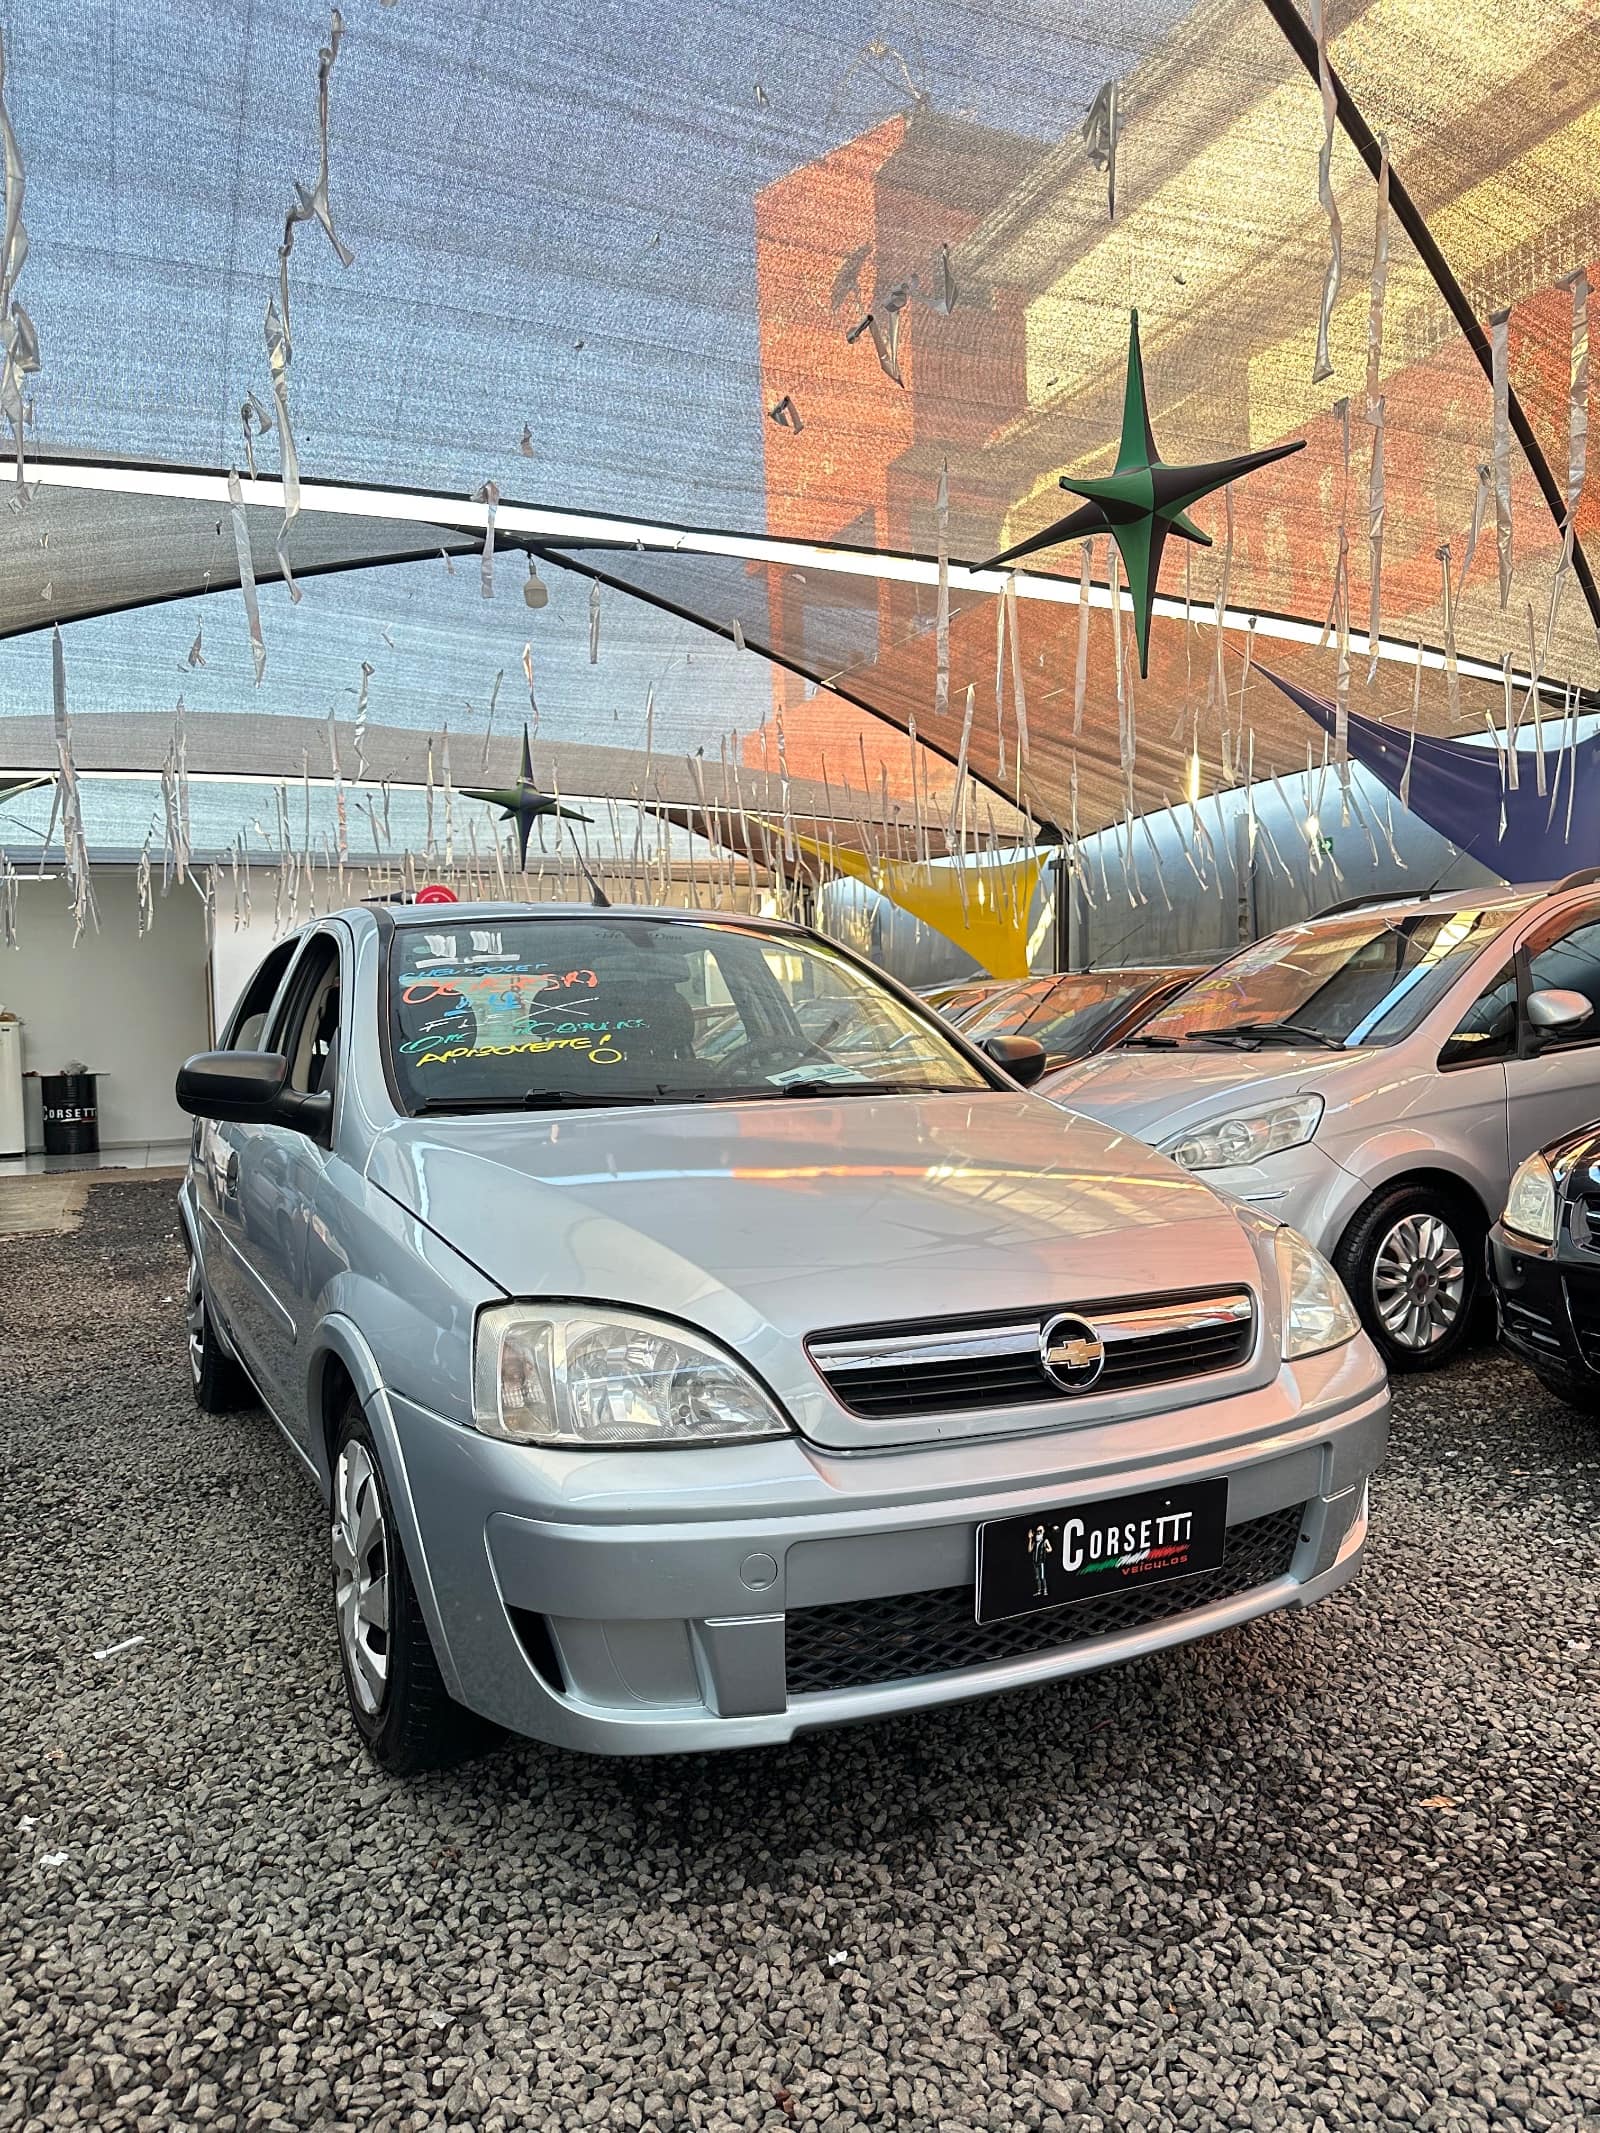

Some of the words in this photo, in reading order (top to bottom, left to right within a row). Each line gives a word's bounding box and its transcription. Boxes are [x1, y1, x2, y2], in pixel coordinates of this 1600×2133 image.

[400, 963, 549, 983] CHEVROLET
[42, 1105, 97, 1121] CORSETT
[1062, 1511, 1193, 1572] CORSETTI
[1121, 1554, 1189, 1576] VEÍCULOS
